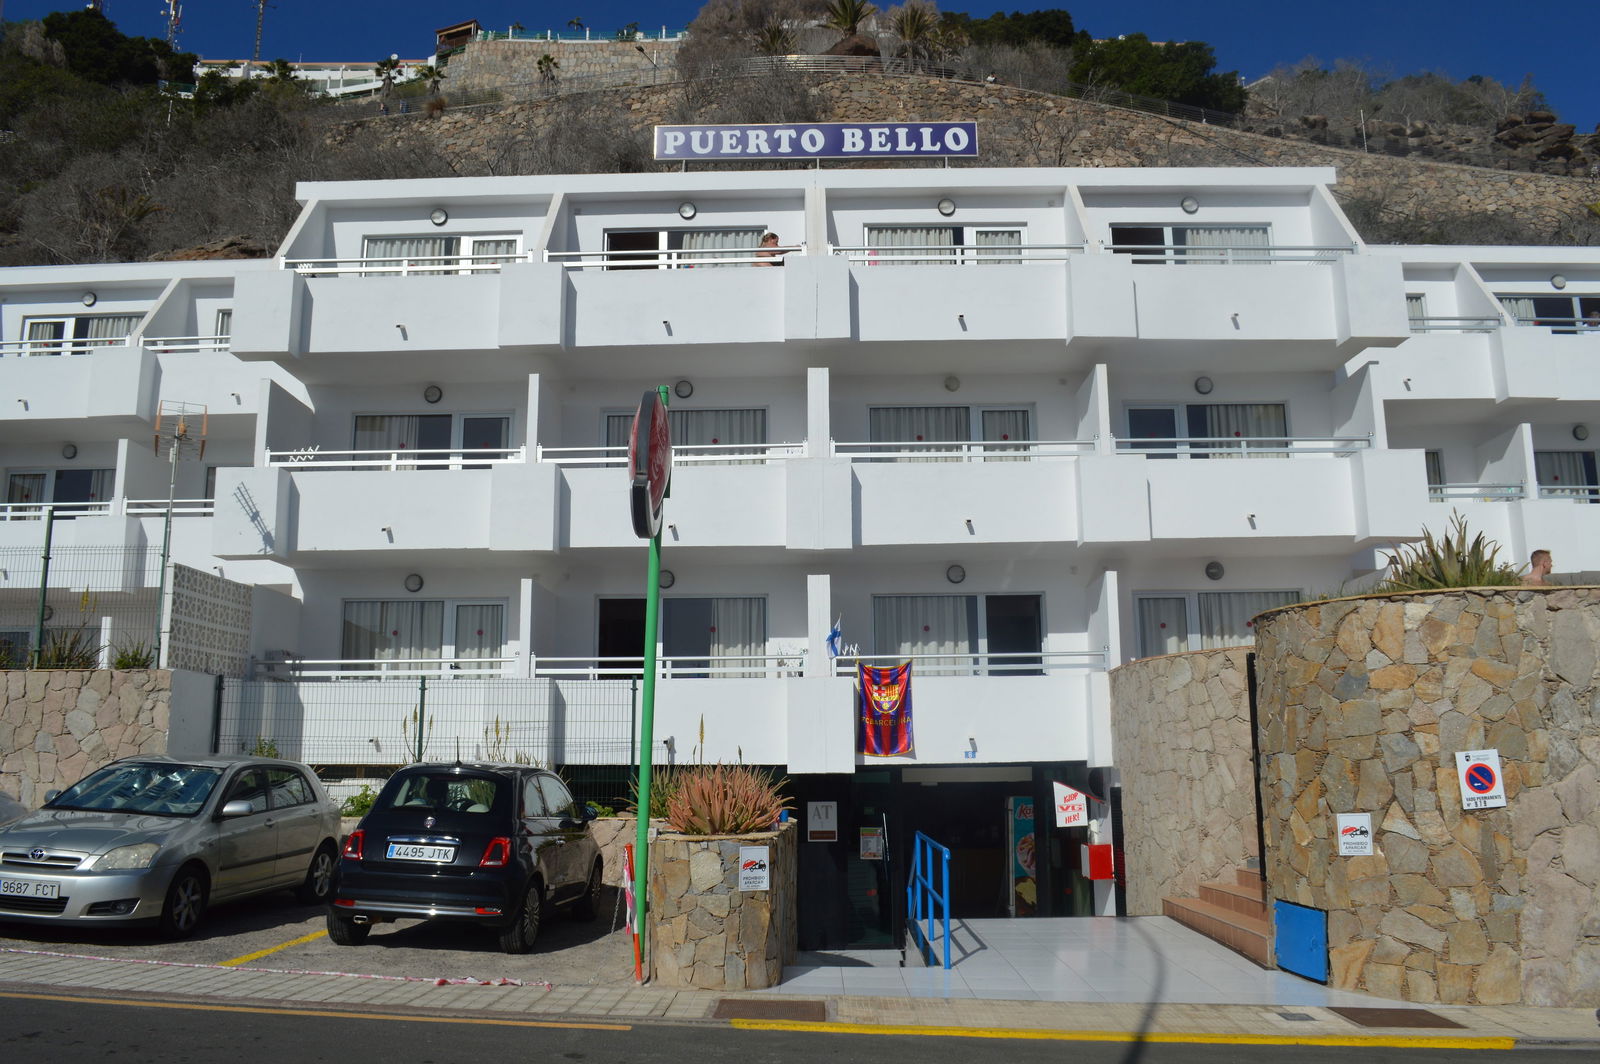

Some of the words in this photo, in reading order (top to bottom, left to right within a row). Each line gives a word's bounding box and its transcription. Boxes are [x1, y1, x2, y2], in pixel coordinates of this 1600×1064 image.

[664, 128, 825, 154] PUERTO
[841, 127, 969, 152] BELLO
[813, 805, 832, 819] AT
[396, 847, 424, 857] 4495
[428, 848, 450, 859] JTK
[2, 882, 29, 894] 9687
[35, 884, 56, 896] FCT
